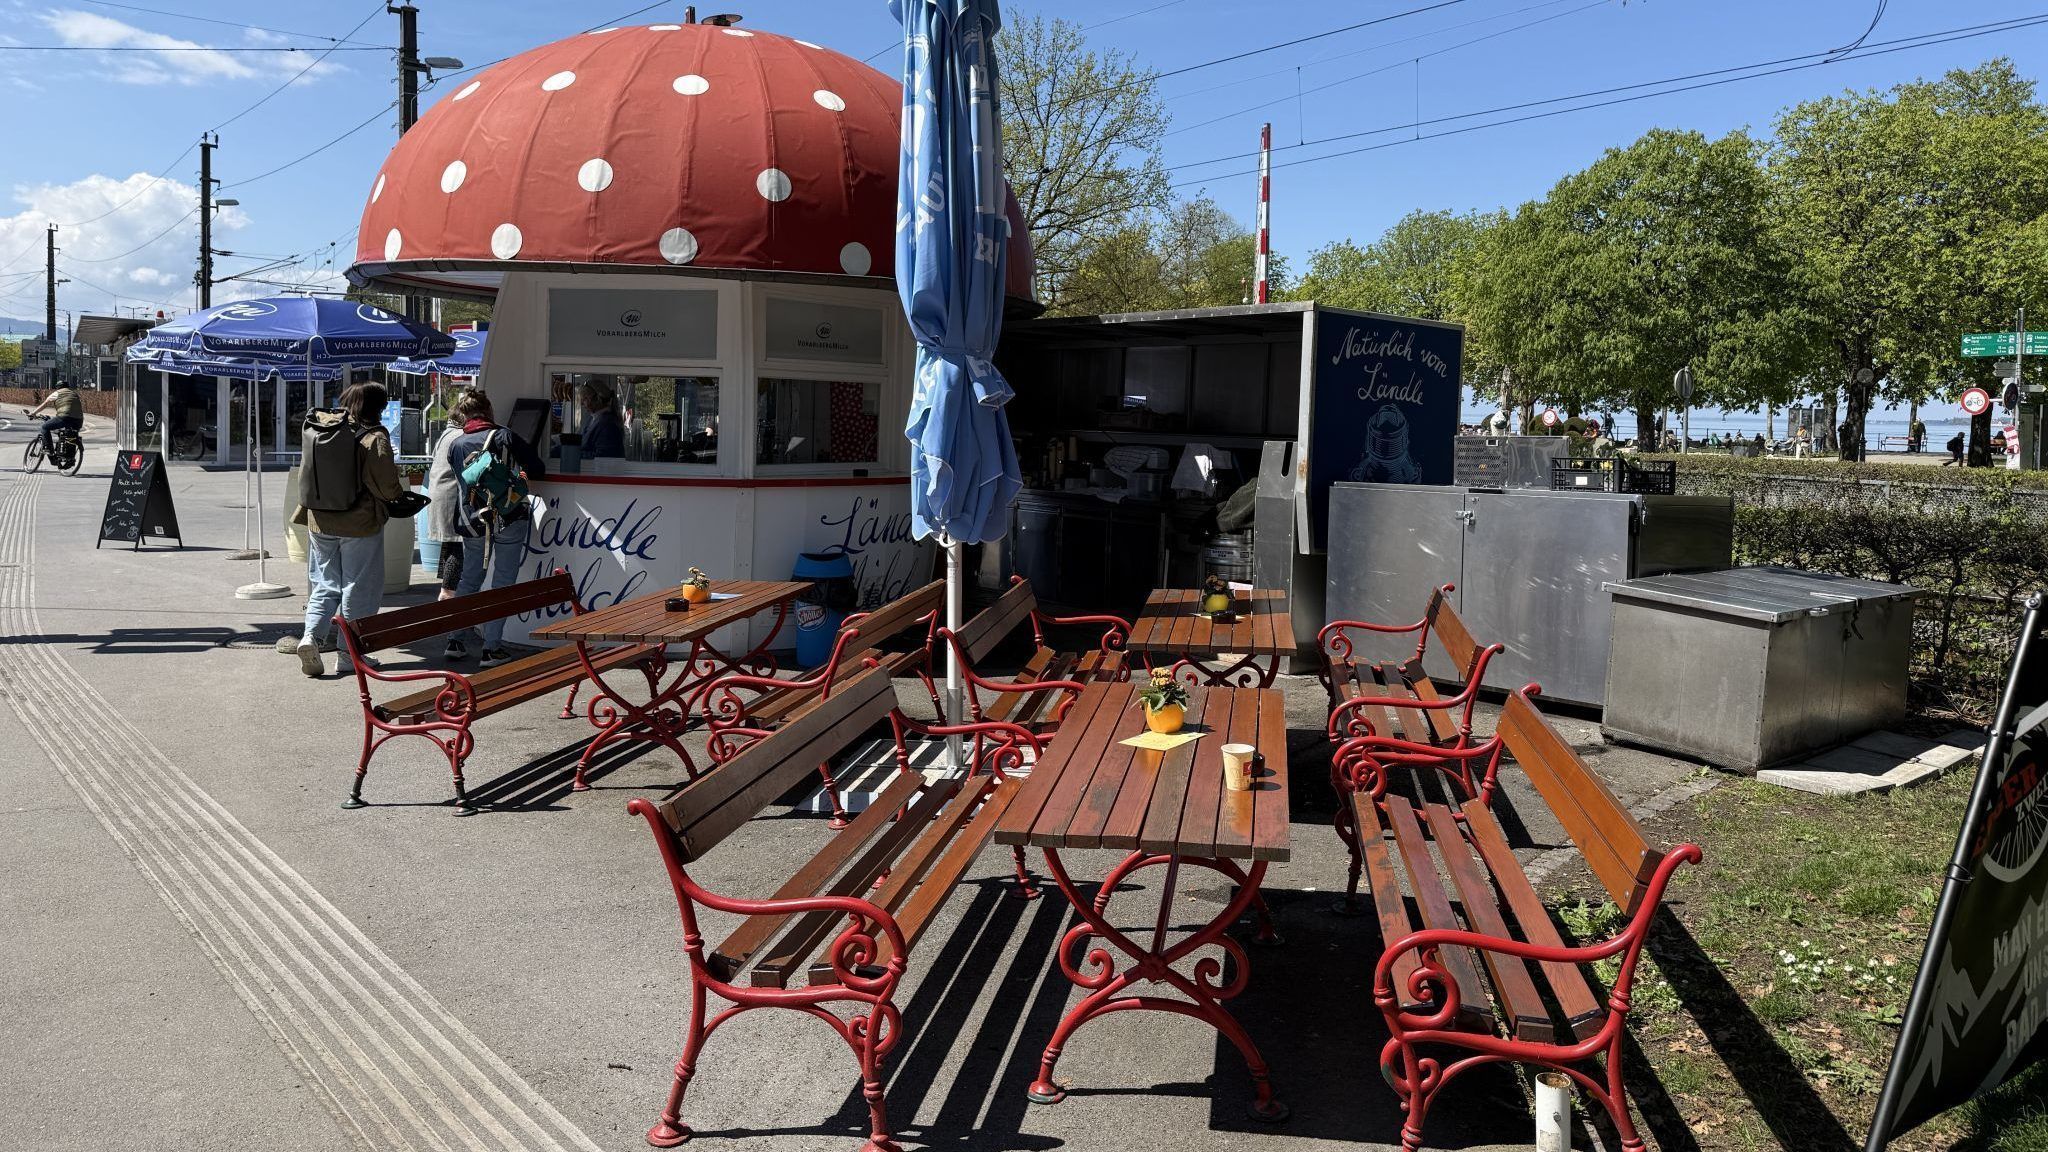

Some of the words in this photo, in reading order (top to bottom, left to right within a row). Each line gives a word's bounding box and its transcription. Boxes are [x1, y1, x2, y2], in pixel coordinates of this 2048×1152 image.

[209, 338, 300, 349] VORARLBERGMILCH
[334, 339, 418, 350] VORARLBERGMILCH
[596, 329, 666, 338] VORARLBERGMILCH
[1332, 326, 1414, 365] Natürlich
[1420, 348, 1447, 378] vom
[1357, 362, 1424, 405] Ländle
[1993, 913, 2031, 971] MAN
[2006, 996, 2038, 1058] RAD
